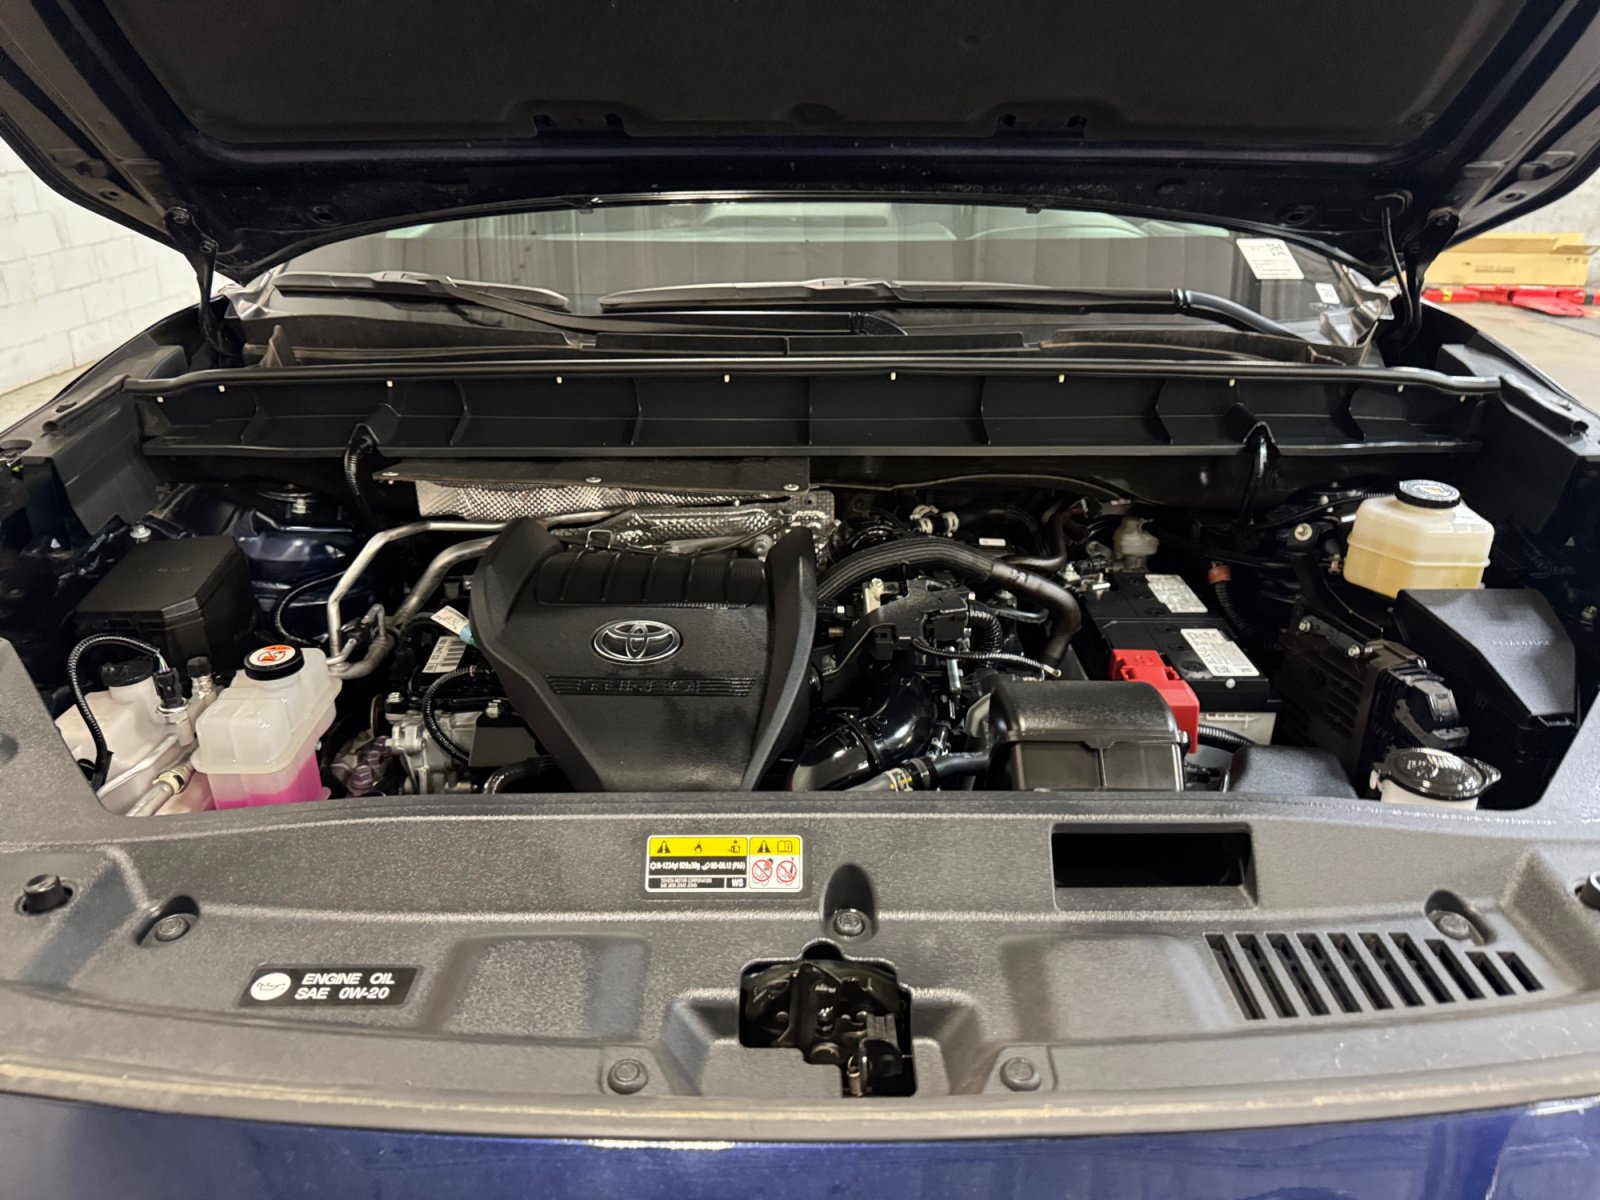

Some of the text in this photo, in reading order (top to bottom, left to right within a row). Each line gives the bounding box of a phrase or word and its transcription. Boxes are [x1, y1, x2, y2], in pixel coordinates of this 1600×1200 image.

[731, 878, 744, 888] WS
[302, 973, 395, 985] ENGINE OIL
[295, 987, 390, 999] SAE 0W-20
